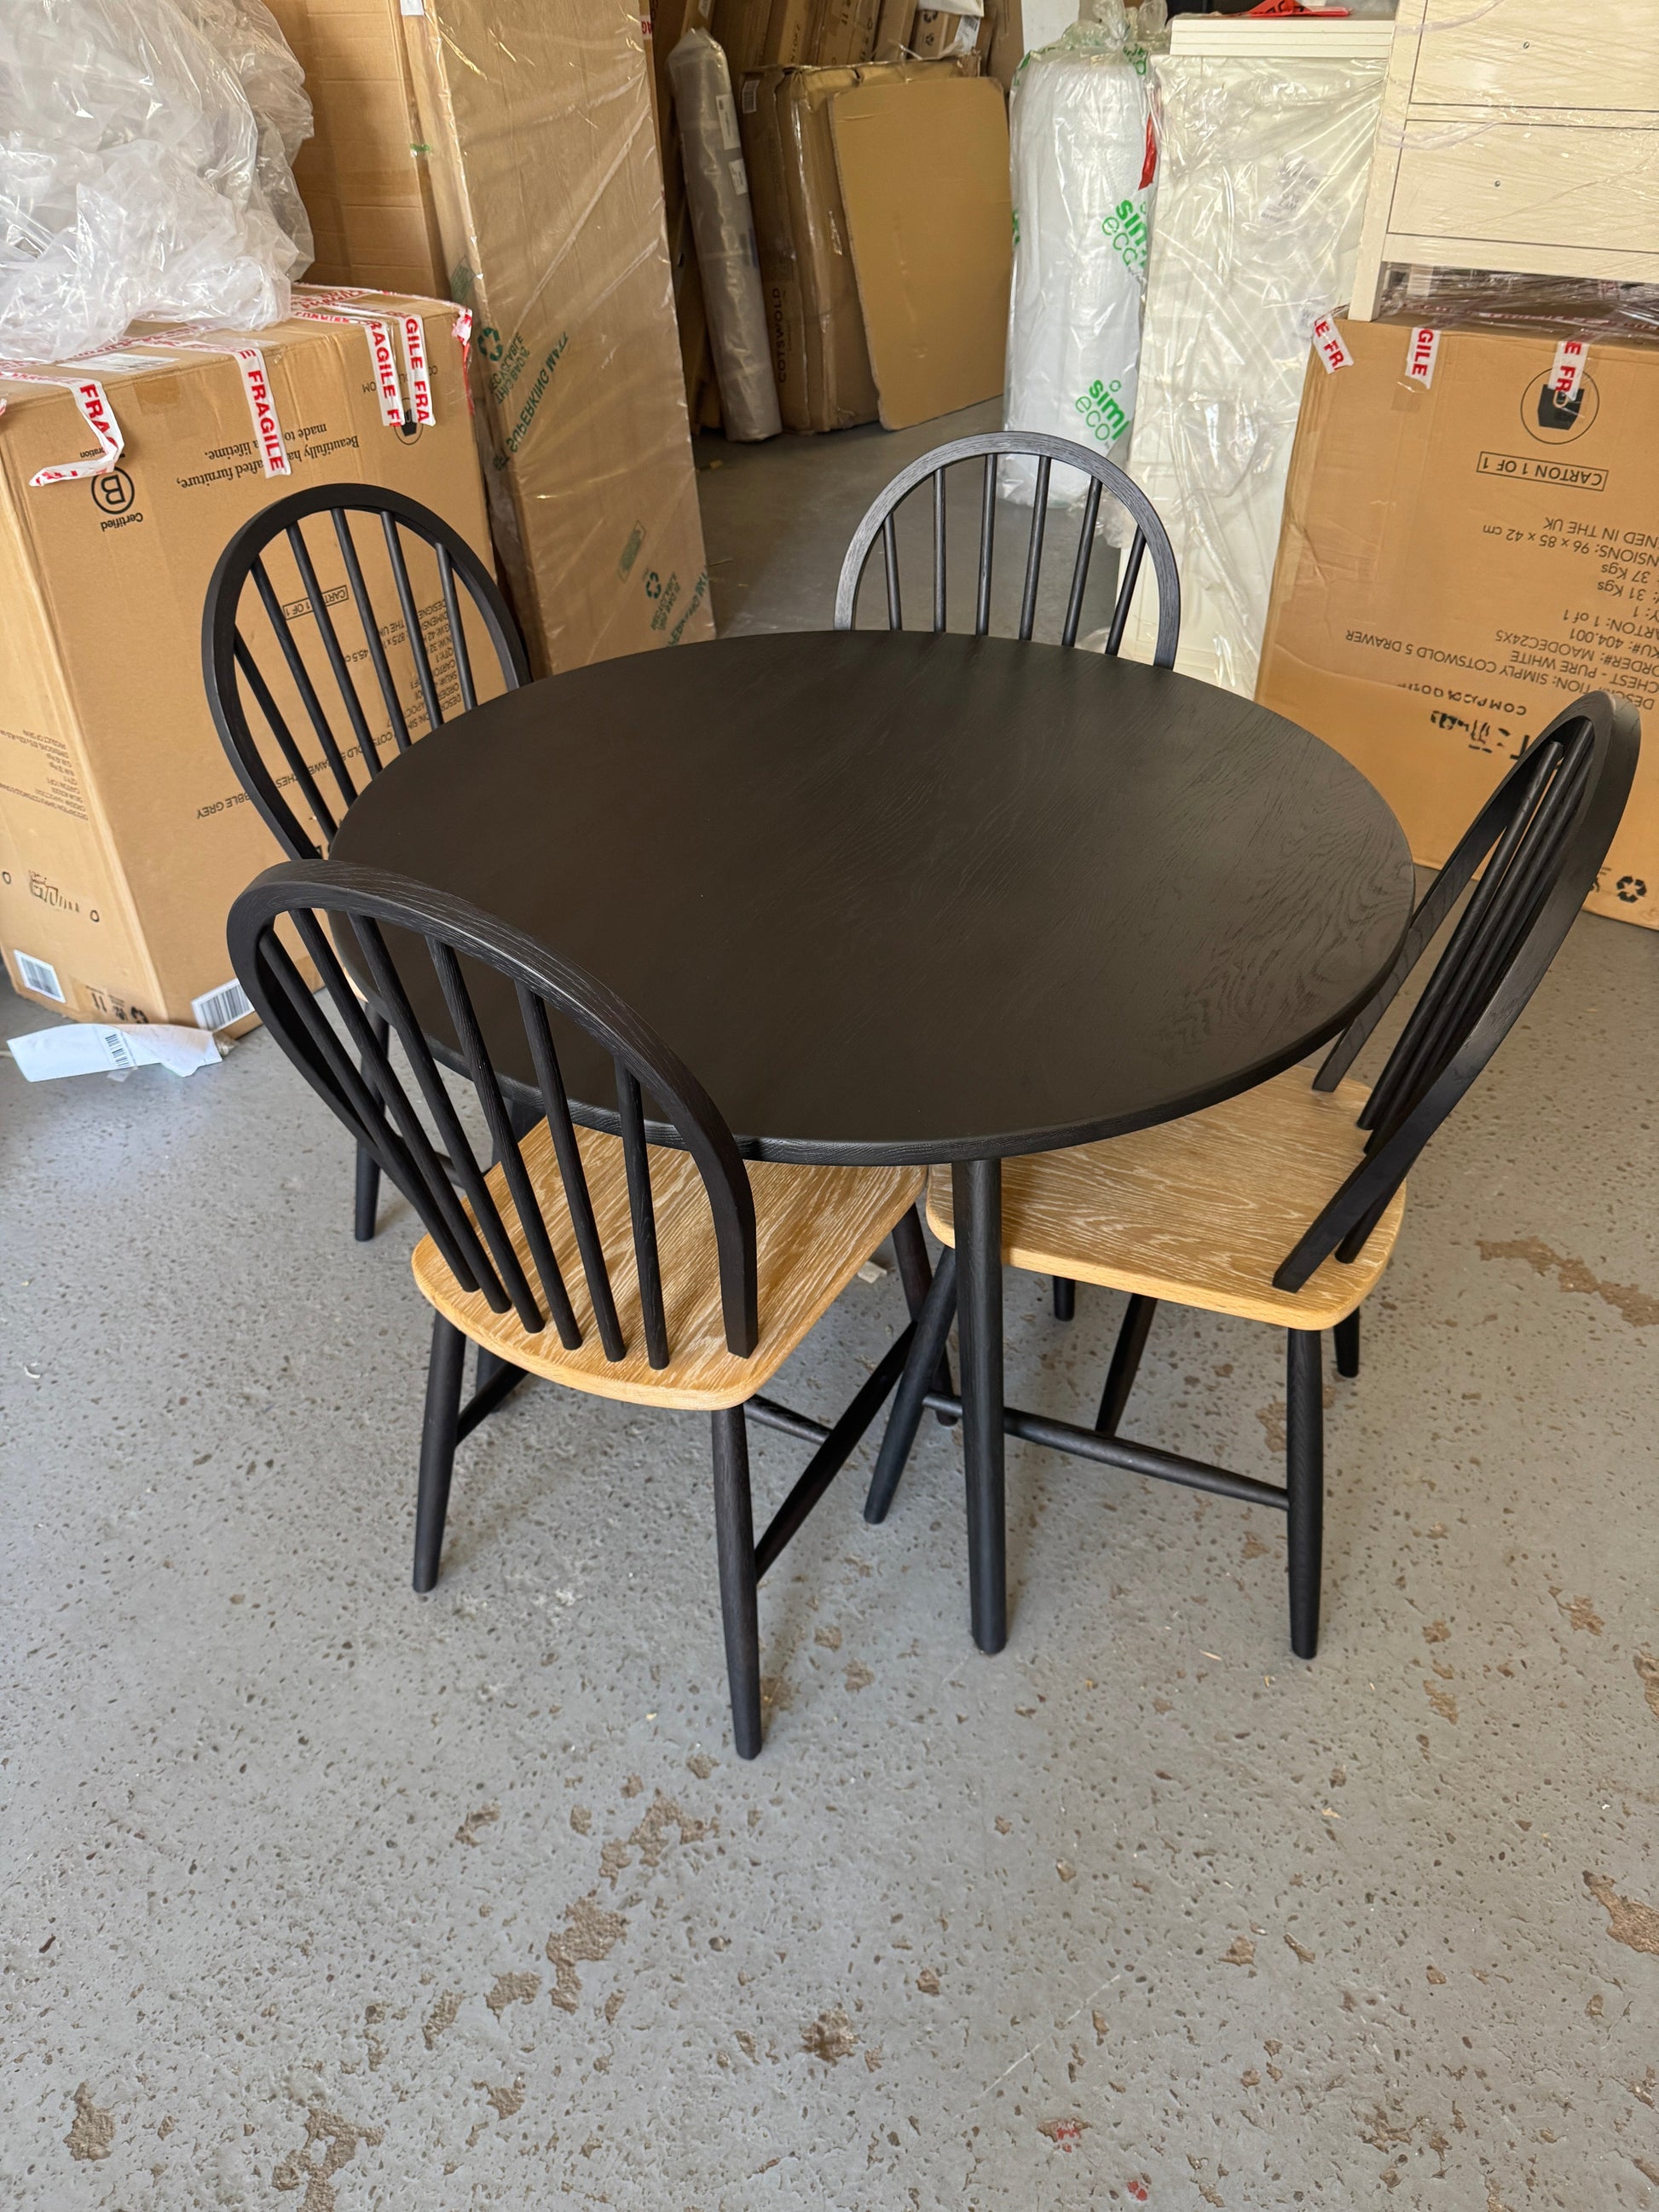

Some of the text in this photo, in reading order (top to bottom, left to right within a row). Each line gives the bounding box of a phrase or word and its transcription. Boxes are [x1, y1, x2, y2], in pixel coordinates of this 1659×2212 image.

[772, 288, 786, 383] COTSWOLD
[1323, 339, 1344, 370] FR
[247, 370, 285, 471] FRAGILE
[298, 424, 327, 436] made
[284, 430, 296, 441] to
[205, 442, 252, 461] lifetime.
[304, 436, 360, 459] Beautifully
[176, 466, 234, 489] furniture,
[1482, 457, 1603, 486] CARTON 1 OF 1
[101, 512, 143, 532] Certified
[1542, 517, 1564, 532] UK
[1567, 522, 1597, 538] THE
[1602, 528, 1620, 541] IN
[1483, 524, 1659, 568] NSIONS: 96 x 85 x 42 cm
[1601, 562, 1650, 584] 37 Kgs
[325, 590, 346, 604] CART
[1597, 580, 1646, 602] 31 Kgs
[292, 604, 304, 615] OF
[1633, 606, 1639, 618] 1
[390, 620, 405, 633] THE
[1563, 609, 1659, 639] ARTON: 1 of 1
[1345, 629, 1402, 653] DRAWER
[1405, 644, 1413, 656] 5
[1495, 629, 1595, 661] MAODEC24X5
[1569, 628, 1659, 659] KU#: 404.001
[1416, 646, 1497, 673] COTSWOLD
[1510, 650, 1557, 670] WHITE
[1500, 665, 1549, 685] SIMPLY
[1559, 661, 1598, 679] PURE
[1609, 673, 1659, 694] CHEST
[196, 801, 224, 819] GREY
